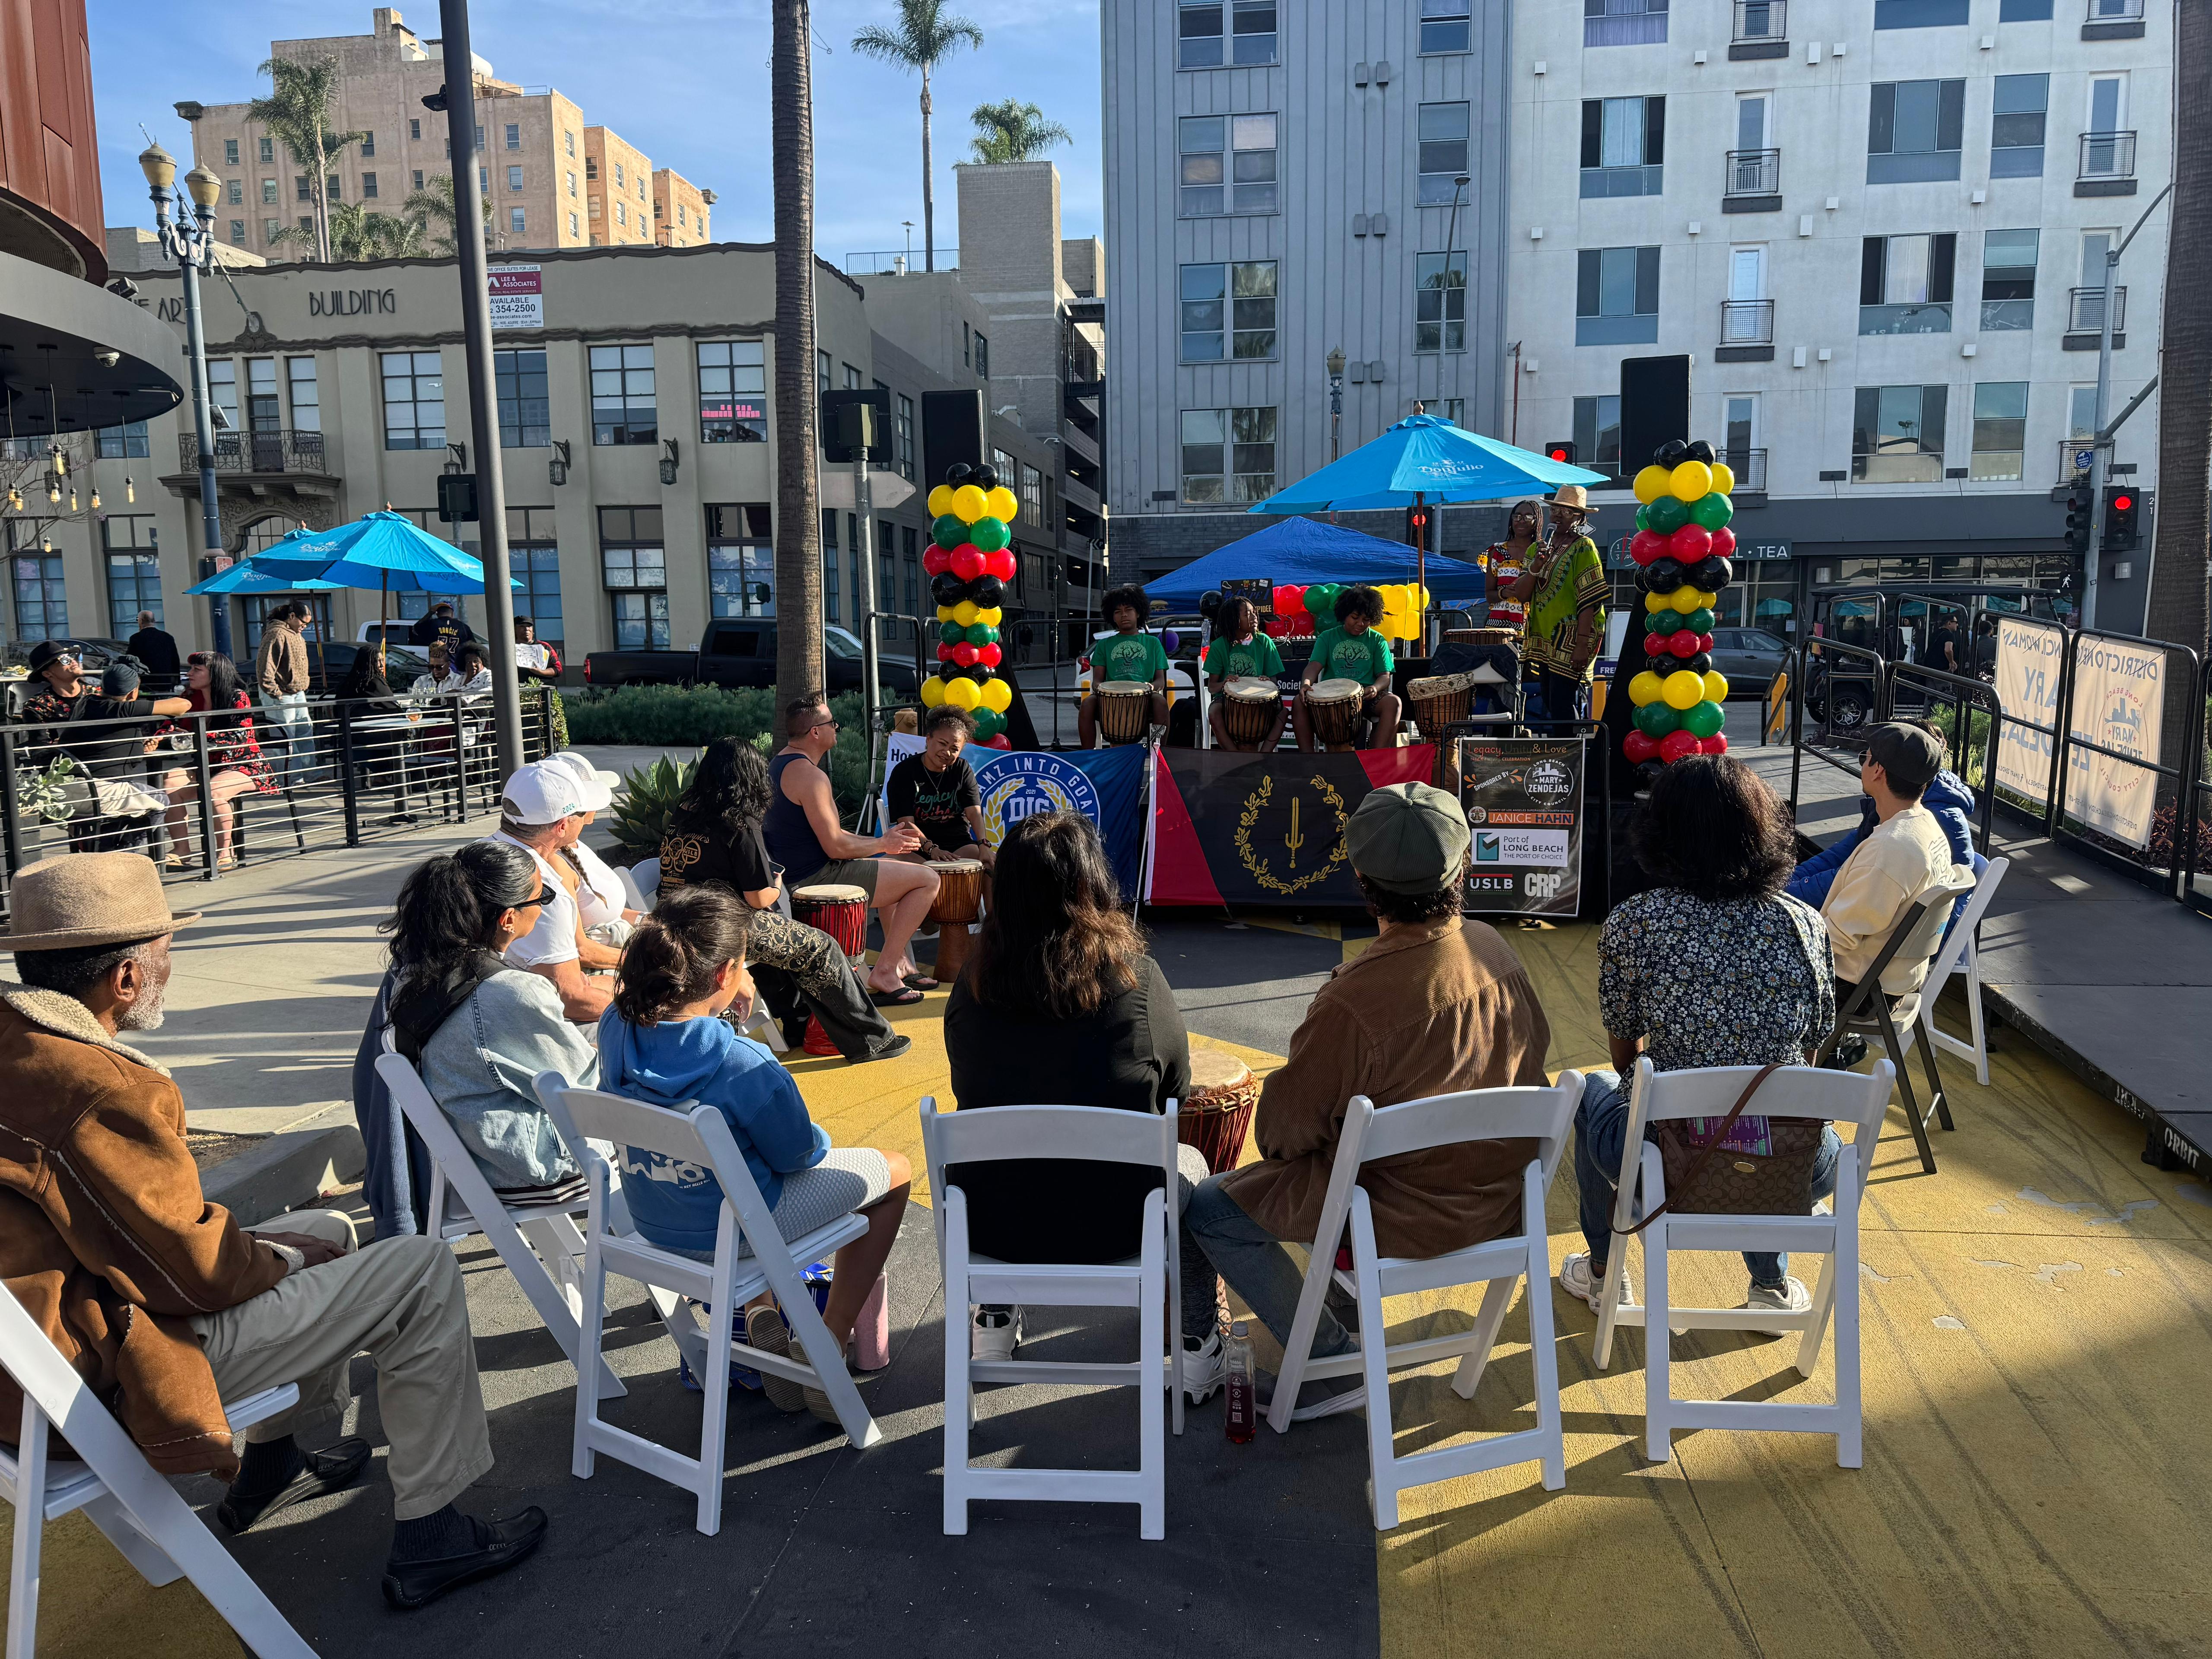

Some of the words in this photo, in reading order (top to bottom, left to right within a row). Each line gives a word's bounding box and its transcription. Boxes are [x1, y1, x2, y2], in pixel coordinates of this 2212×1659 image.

[308, 289, 395, 317] BUILDING
[496, 304, 536, 313] 354-2500
[1757, 546, 1788, 558] TEA
[1277, 680, 1301, 690] Societ
[1468, 743, 1504, 756] Legacy,
[1532, 744, 1541, 753] &
[1545, 744, 1567, 753] Love
[1014, 757, 1060, 775] INTO
[1533, 759, 1547, 767] LONG
[1549, 759, 1565, 767] BEACH
[1473, 774, 1502, 791] SPONSORED
[1528, 785, 1569, 793] ZENDEJAS
[1531, 796, 1541, 806] CITY
[1544, 797, 1567, 806] COUNCIL
[1490, 814, 1532, 823] JANICE
[1535, 814, 1572, 823] HAHN
[1470, 878, 1513, 889] USLB
[1525, 873, 1560, 897] CRP
[2164, 1127, 2199, 1169] ORBIT
